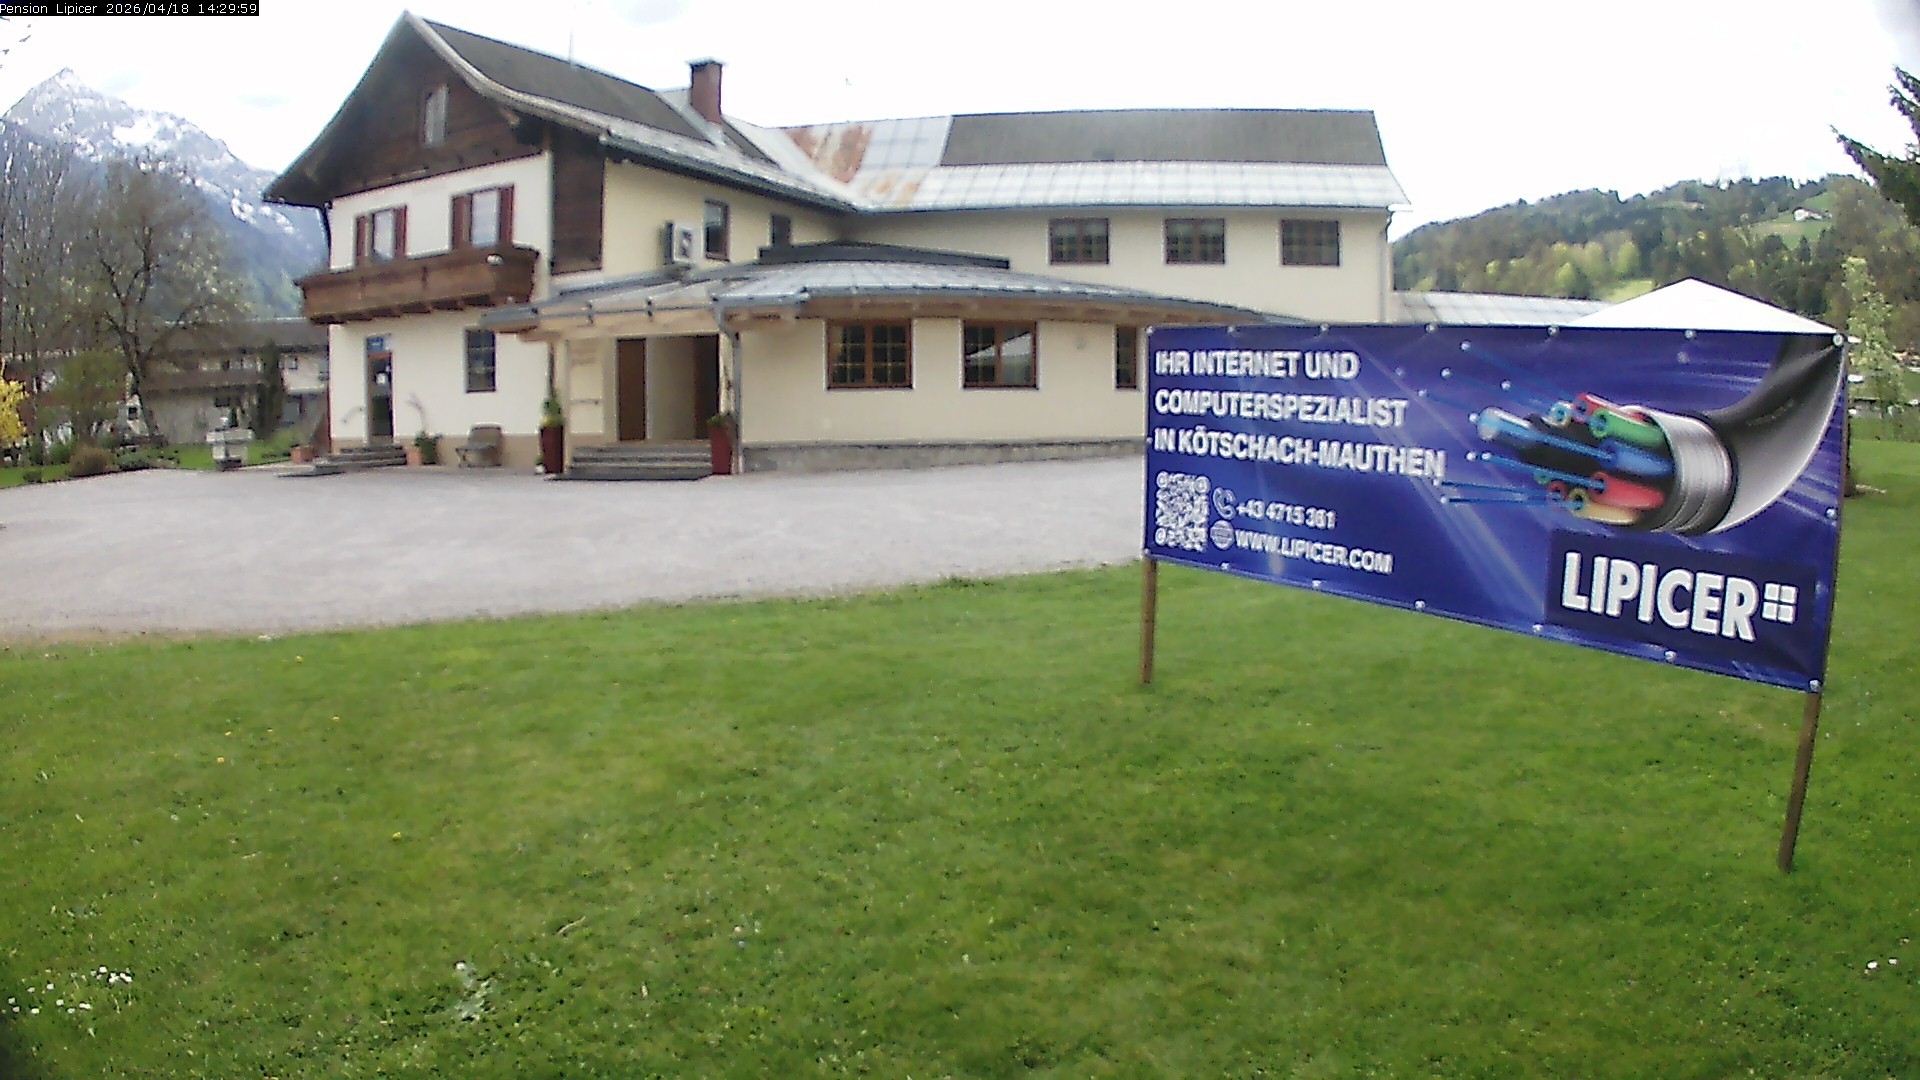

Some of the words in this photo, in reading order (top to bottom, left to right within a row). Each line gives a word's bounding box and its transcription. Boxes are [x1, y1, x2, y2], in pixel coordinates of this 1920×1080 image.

[1155, 350, 1190, 376] IHR
[1193, 350, 1301, 378] INTERNET
[1304, 351, 1361, 380] UND
[1155, 388, 1408, 427] COMPUTERSPEZIALIST
[1154, 427, 1176, 452] IN
[1178, 425, 1447, 477] KÖTSCHACH-MAUTHEN
[1236, 499, 1265, 519] +43
[1266, 502, 1305, 526] 4715
[1235, 529, 1393, 575] WWW.LIPICER.COM
[1561, 551, 1760, 642] LIPICER
